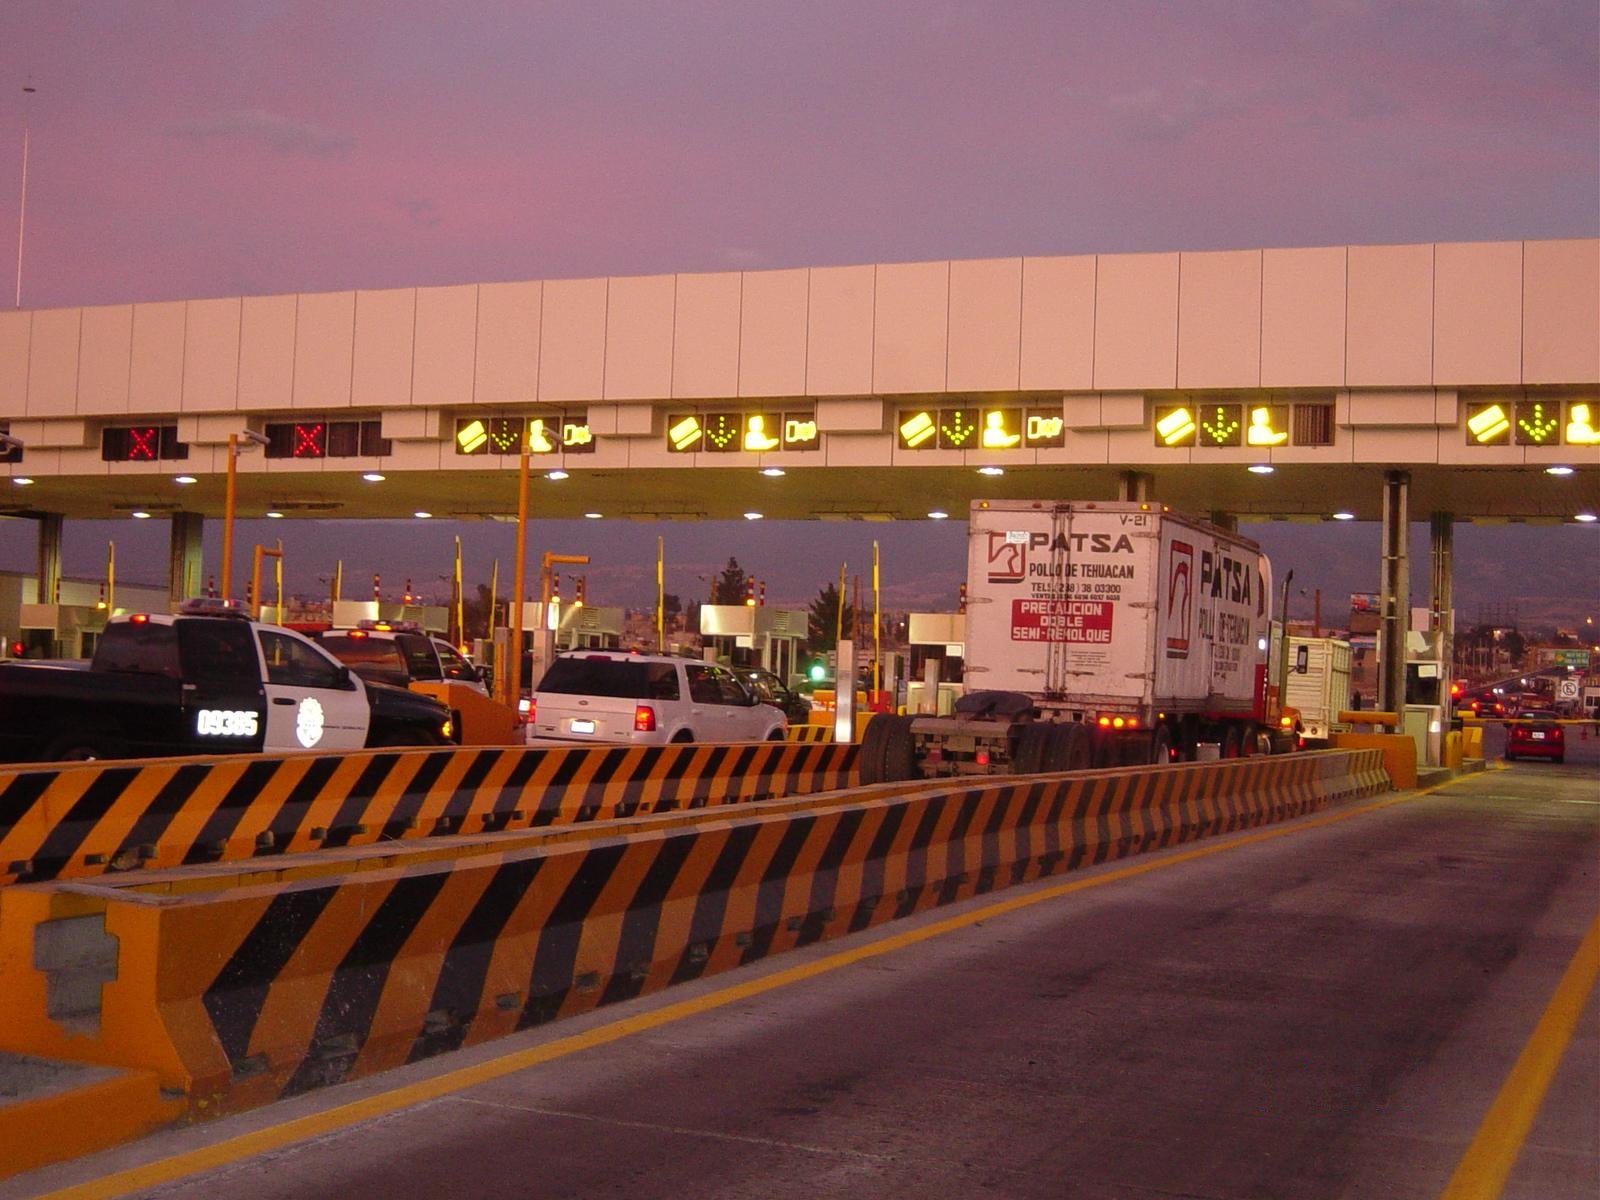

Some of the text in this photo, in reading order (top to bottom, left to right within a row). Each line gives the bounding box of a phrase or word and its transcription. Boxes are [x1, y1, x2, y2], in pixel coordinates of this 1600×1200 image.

[1120, 515, 1147, 526] V-21
[1029, 532, 1135, 553] PATSA
[1029, 562, 1135, 579] POLLO DE TEHUACAN
[1201, 550, 1251, 606] PATSA
[1021, 601, 1103, 616] PRECAUCION
[1040, 615, 1083, 627] DOBLE
[1013, 626, 1110, 642] SEMI-REMOLQUE
